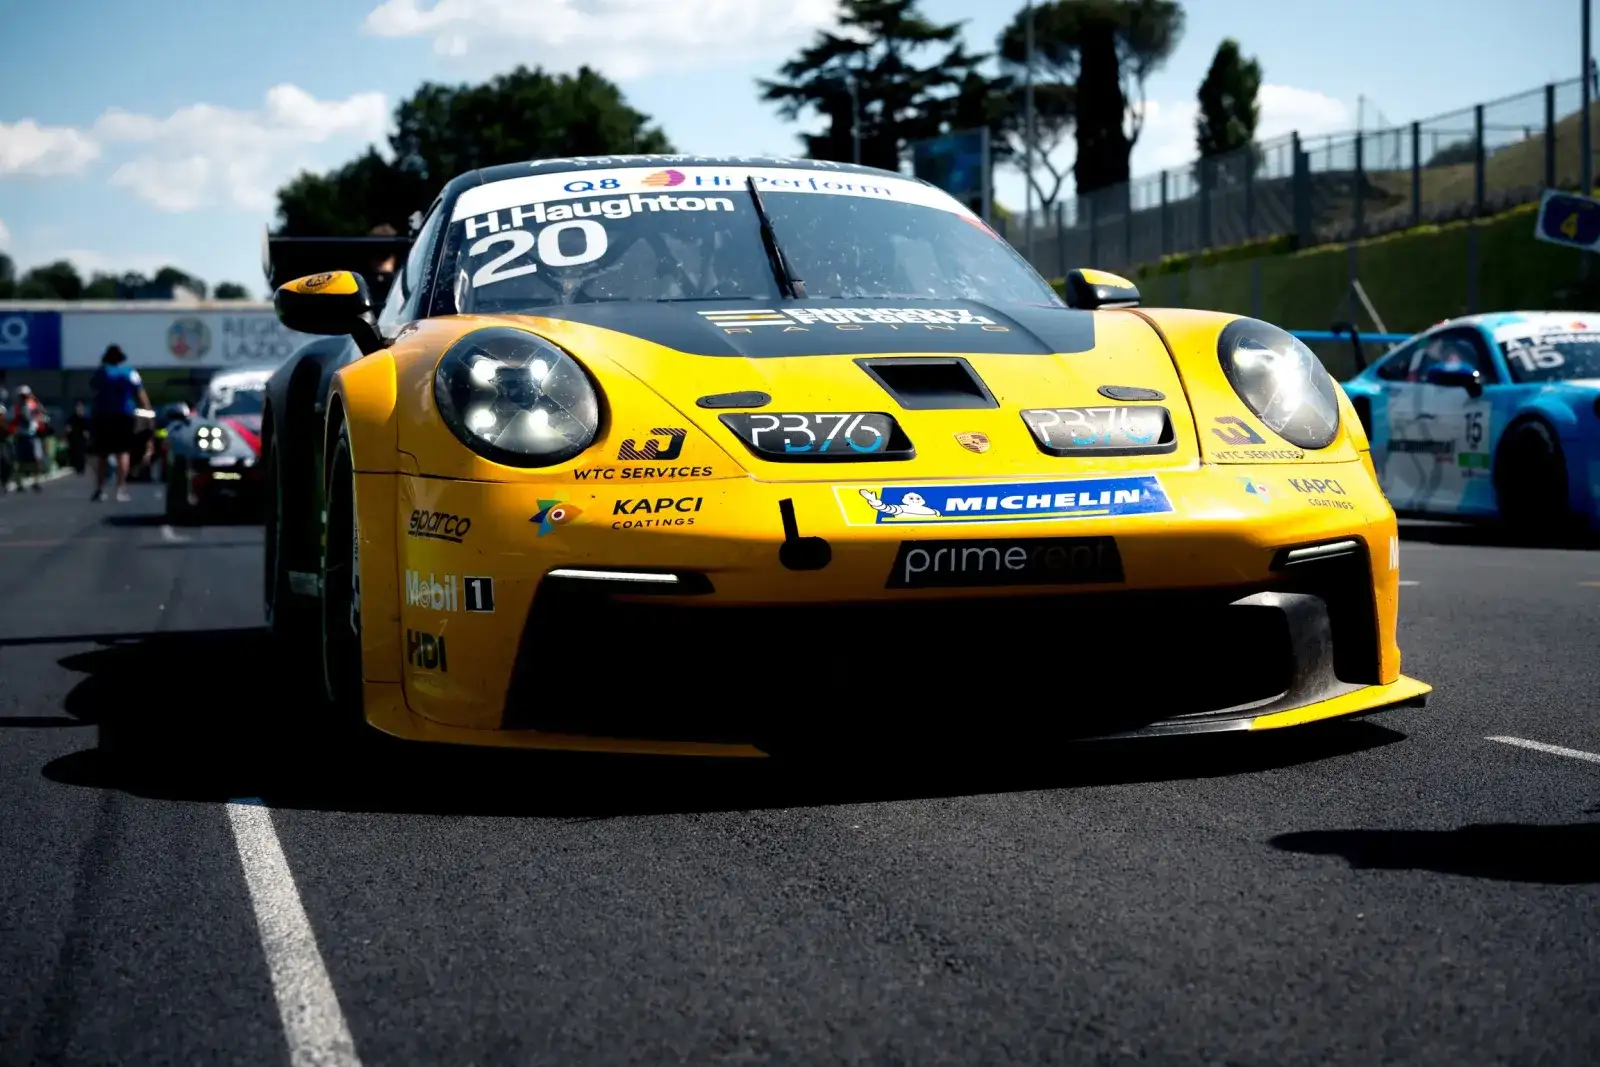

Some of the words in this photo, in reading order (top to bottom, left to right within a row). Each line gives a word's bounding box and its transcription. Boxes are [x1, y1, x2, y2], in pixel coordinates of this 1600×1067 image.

[563, 178, 621, 193] Q8
[695, 175, 732, 186] Hi
[752, 176, 892, 196] Perform
[465, 193, 735, 240] H.Haughton
[468, 219, 608, 289] 20
[723, 324, 1011, 335] RACING
[1507, 342, 1565, 372] 15
[1464, 411, 1484, 443] 15
[1212, 450, 1240, 460] WTC
[1244, 450, 1305, 460] SERVICES
[573, 468, 616, 480] WTC
[620, 466, 713, 479] SERVICES
[1287, 478, 1346, 495] KAPCI
[612, 497, 703, 515] KAPCI
[945, 488, 1140, 512] MICHELIN
[1308, 498, 1354, 511] COATINGS
[409, 508, 471, 537] sparco
[611, 517, 695, 530] COATINGS
[405, 569, 458, 612] Mobil
[406, 627, 447, 673] HDI
